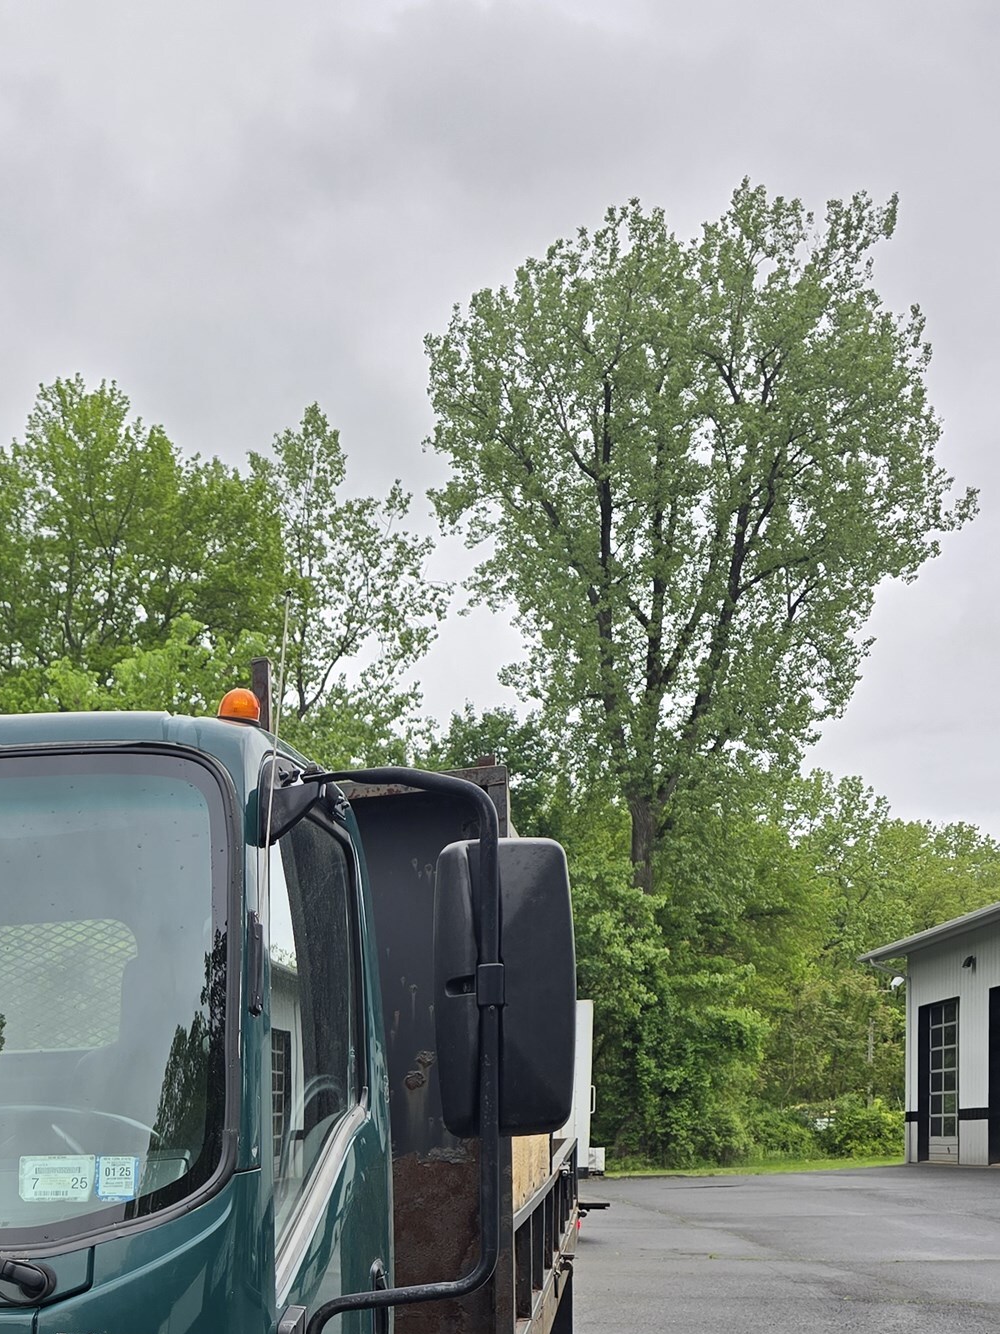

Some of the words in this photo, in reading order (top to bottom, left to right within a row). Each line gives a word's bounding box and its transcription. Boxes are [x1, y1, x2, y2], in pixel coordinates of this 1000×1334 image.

[104, 1166, 115, 1177] 01
[119, 1166, 132, 1177] 25
[31, 1177, 39, 1190] 7
[70, 1176, 88, 1190] 25
